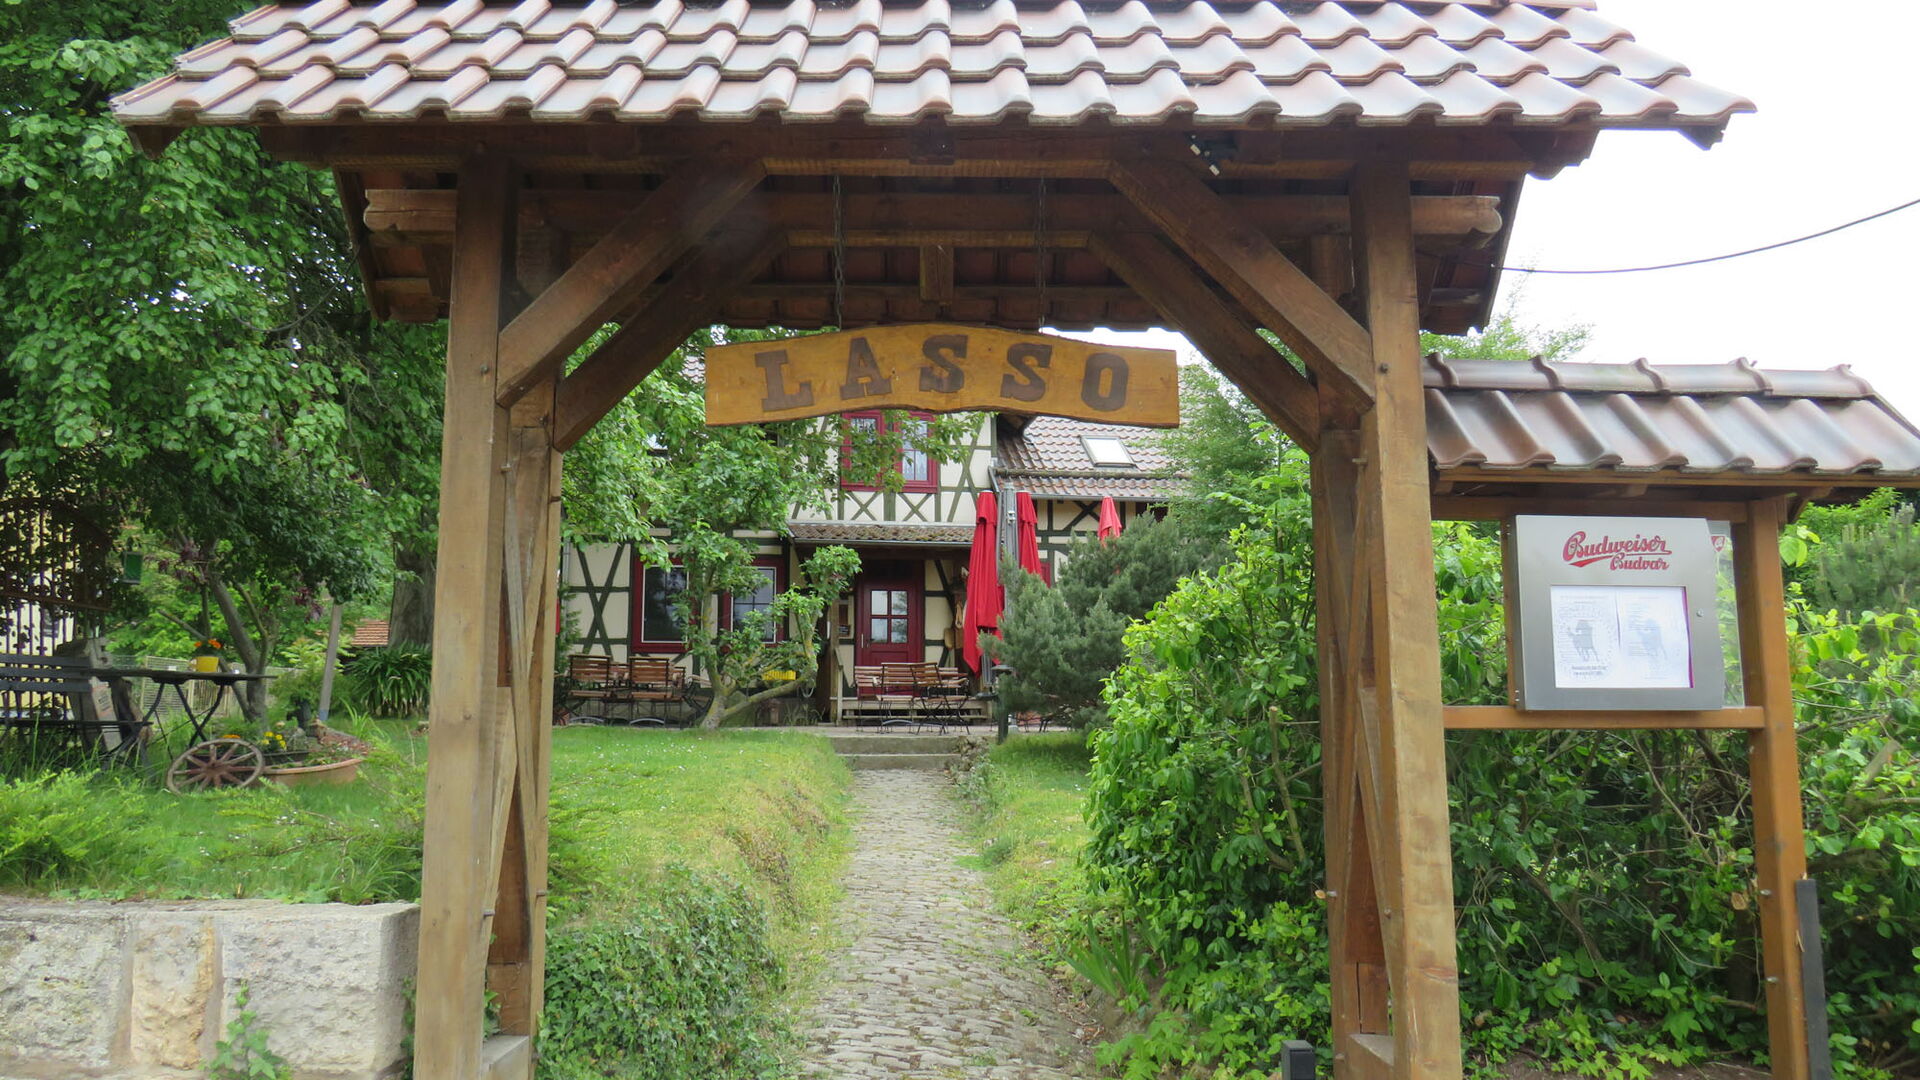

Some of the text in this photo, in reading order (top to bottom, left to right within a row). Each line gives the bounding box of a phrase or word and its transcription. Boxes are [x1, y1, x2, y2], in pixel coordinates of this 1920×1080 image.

[755, 334, 1129, 412] LASSO
[1562, 531, 1671, 562] Budweiser
[1609, 552, 1669, 571] Budvar
